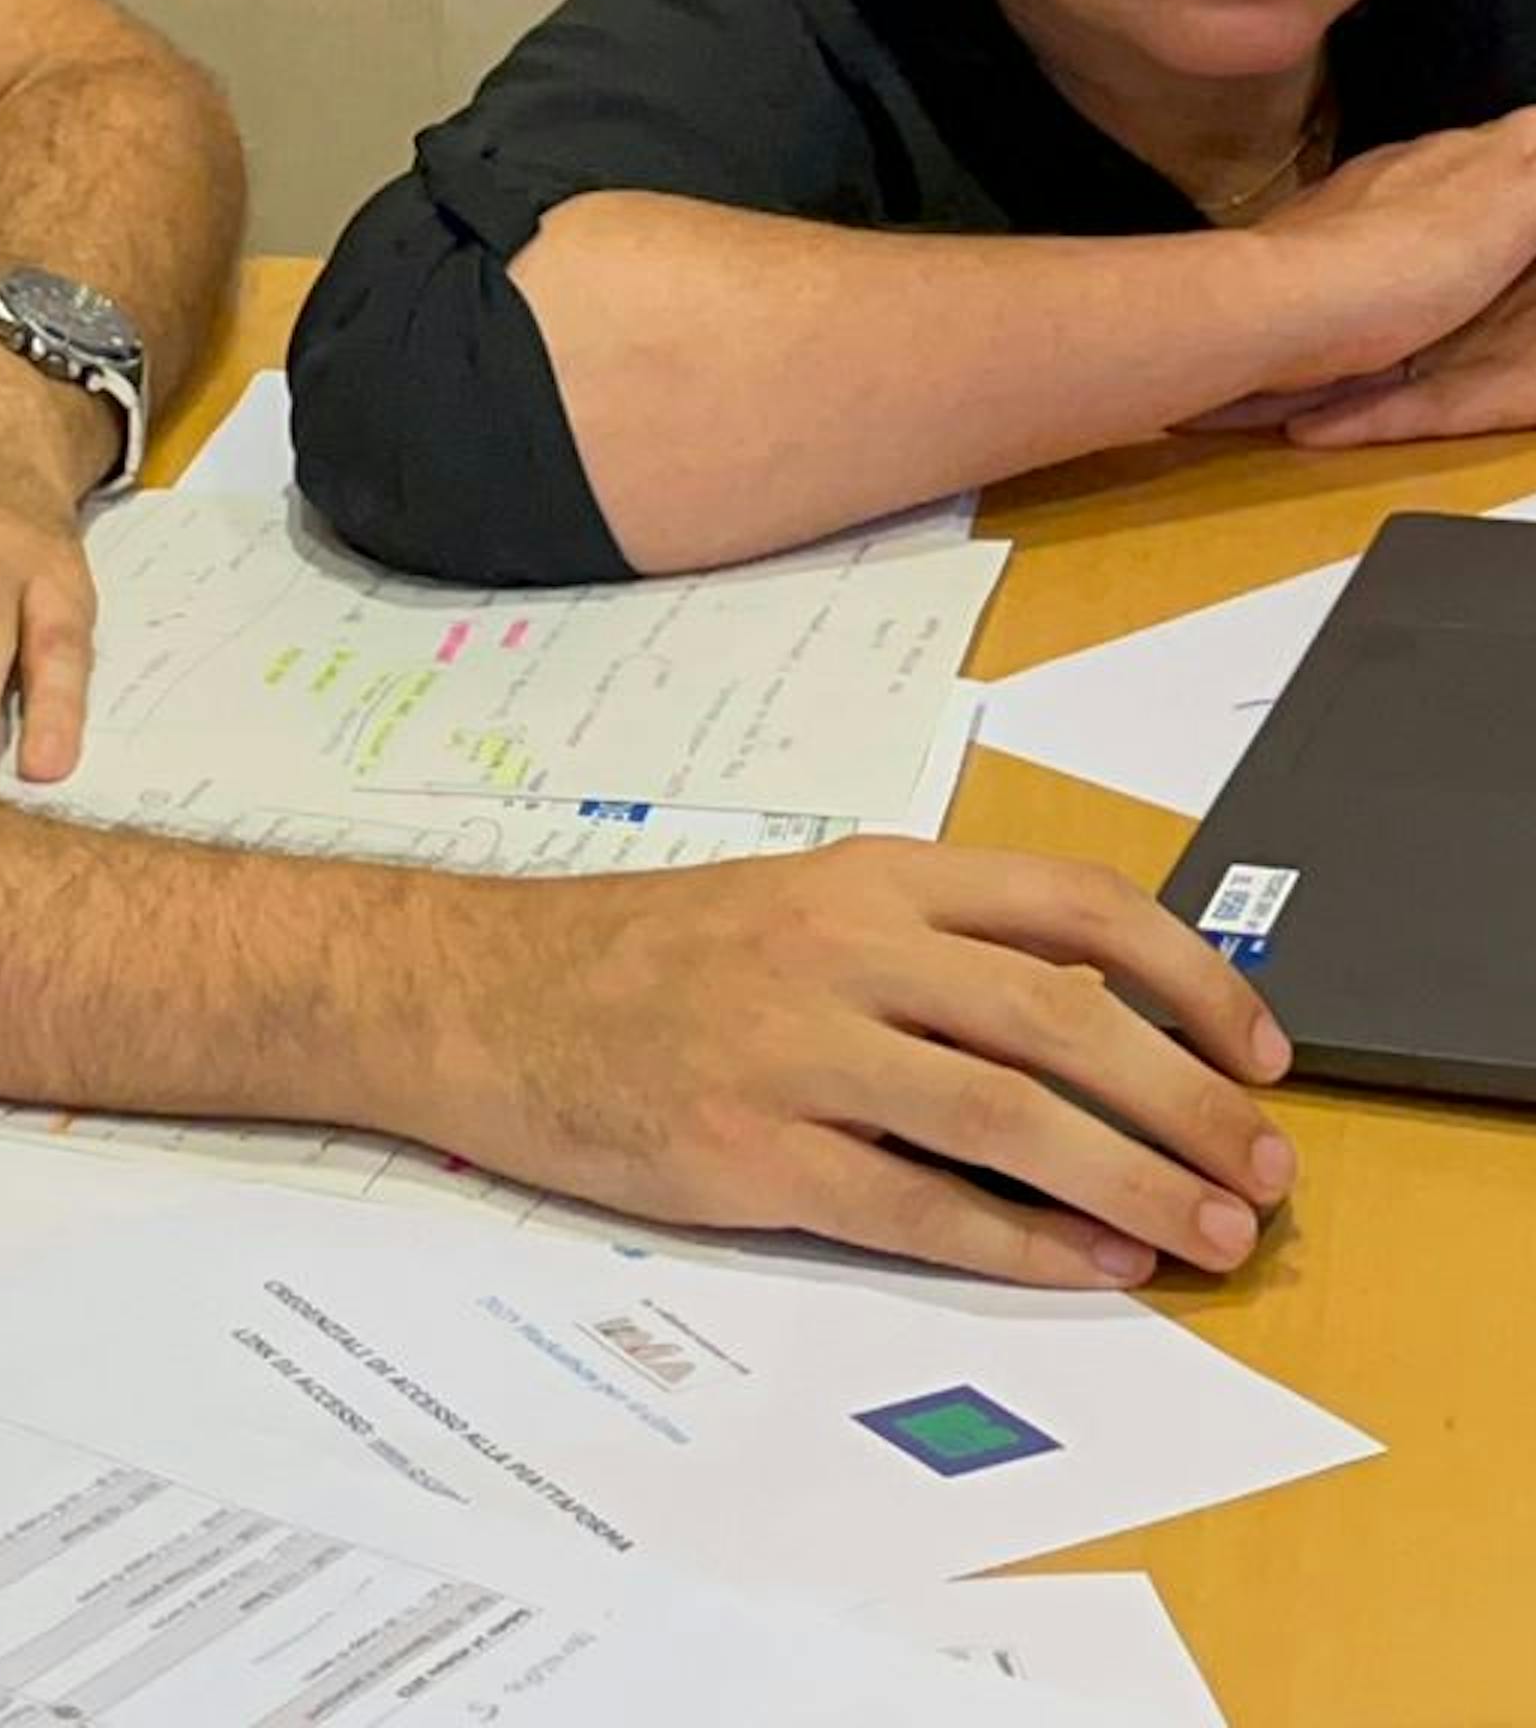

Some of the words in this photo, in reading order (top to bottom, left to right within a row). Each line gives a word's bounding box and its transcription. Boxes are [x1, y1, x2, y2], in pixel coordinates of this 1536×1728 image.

[232, 1327, 280, 1359] LINK
[268, 1358, 303, 1377] DI
[263, 1279, 375, 1358] CREDENZIALI
[363, 1357, 397, 1376] DI
[386, 1376, 469, 1431] ACCESSO
[460, 1432, 512, 1465] ALLA
[503, 1462, 635, 1553] PIATTAFORMA
